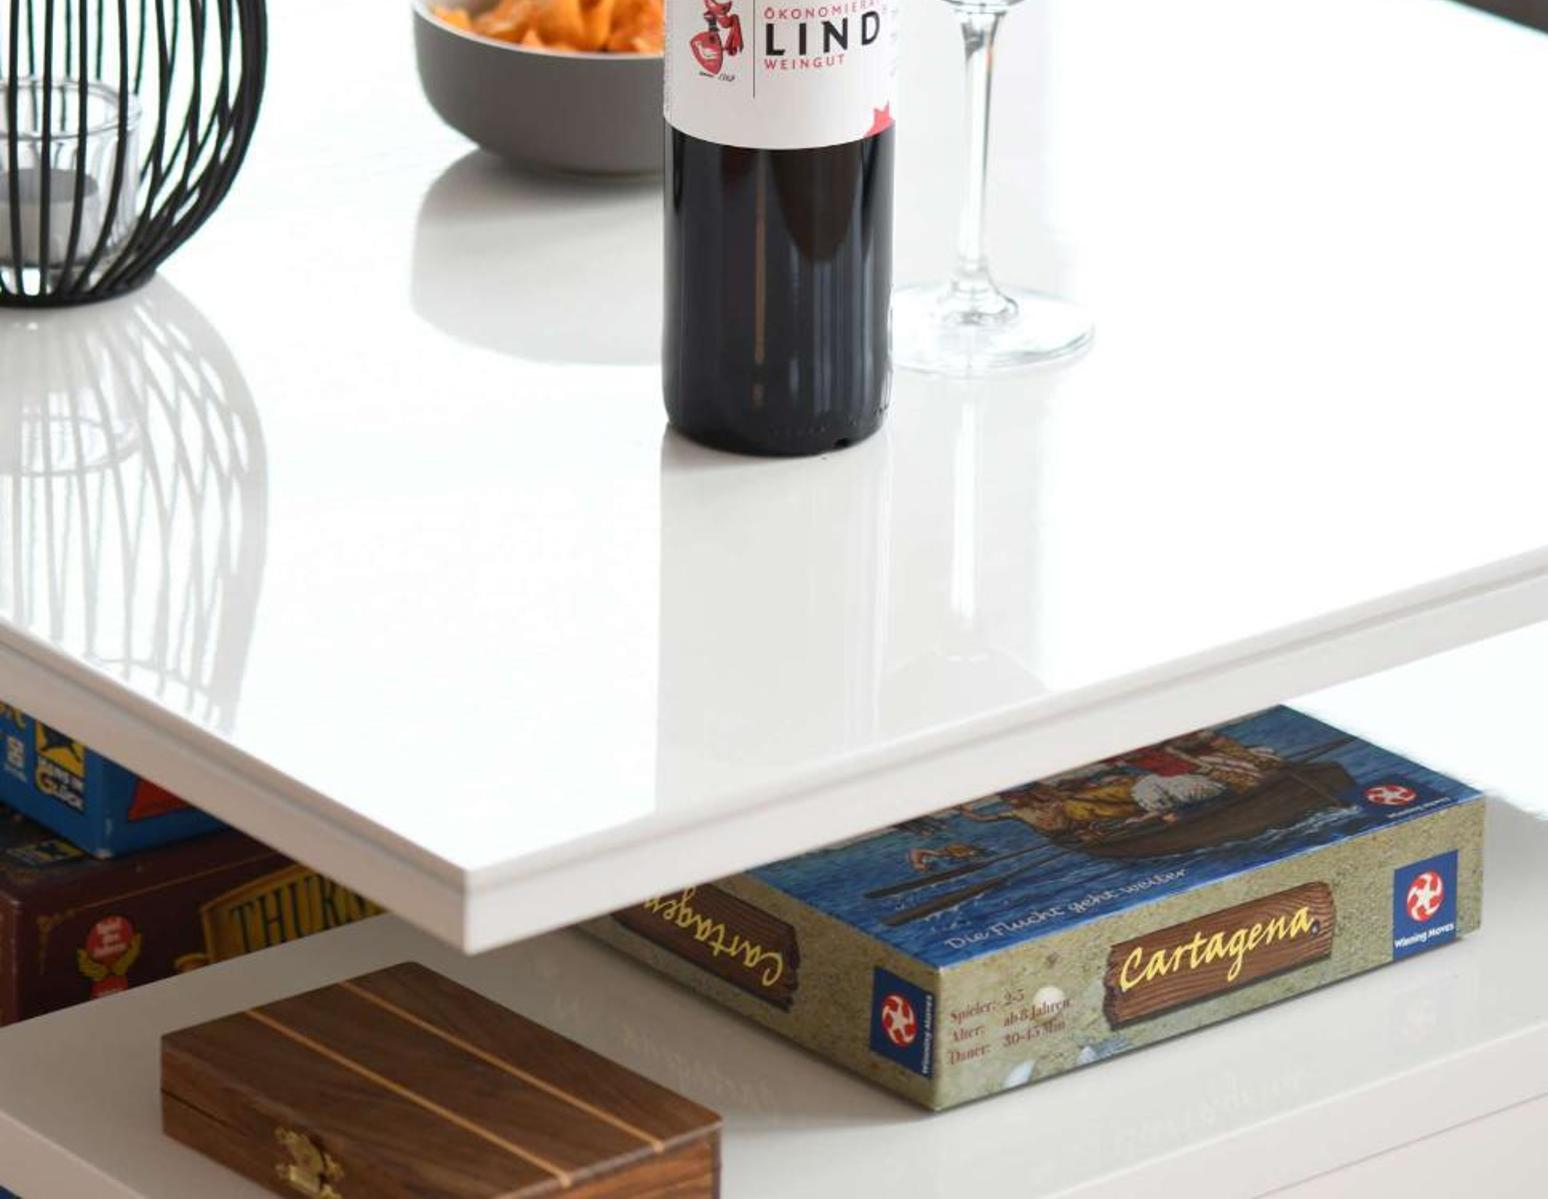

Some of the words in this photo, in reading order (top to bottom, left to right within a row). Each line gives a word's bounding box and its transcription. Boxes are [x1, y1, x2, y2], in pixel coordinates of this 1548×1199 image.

[763, 53, 845, 71] WEINGUT
[765, 10, 881, 56] LIND
[643, 886, 784, 987] Cartagen
[944, 927, 990, 950] Die
[988, 904, 1065, 936] Flucht
[1068, 888, 1120, 914] geht
[1121, 868, 1187, 895] weiter
[1119, 906, 1316, 993] Cartagena
